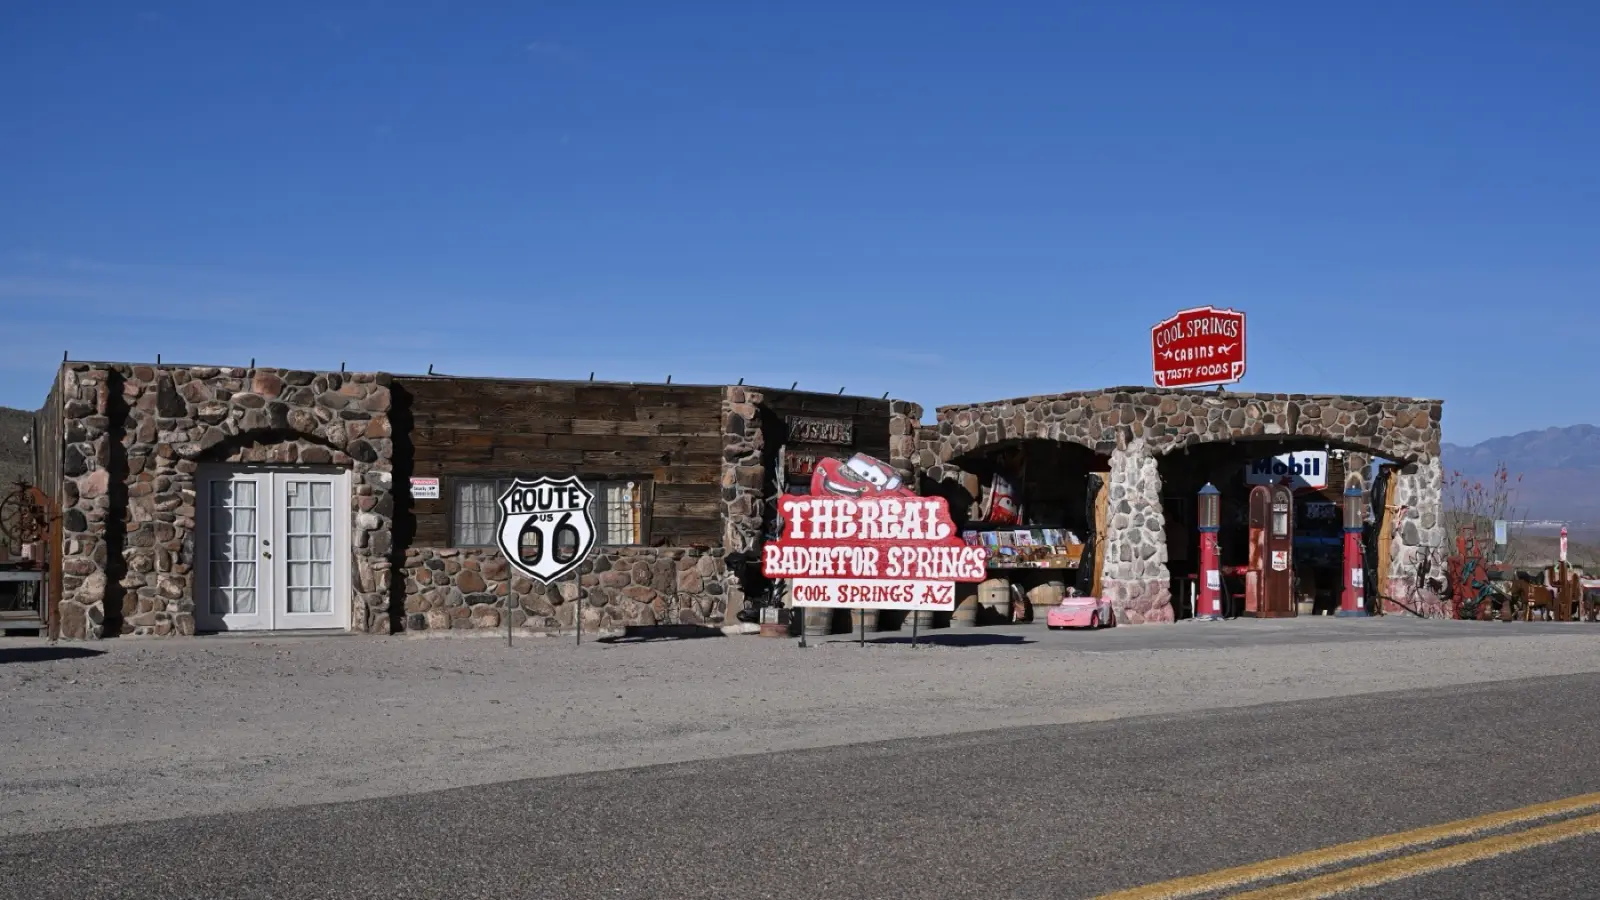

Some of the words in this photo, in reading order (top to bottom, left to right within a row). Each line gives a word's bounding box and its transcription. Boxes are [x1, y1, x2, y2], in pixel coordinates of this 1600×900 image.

[1156, 322, 1185, 348] COOL
[1186, 317, 1239, 338] SPRINGS
[1174, 345, 1215, 361] CABINS
[1166, 367, 1194, 380] TASTY
[1195, 362, 1229, 377] FOODS
[1252, 455, 1320, 476] Mobil
[511, 486, 580, 513] ROUTE
[539, 513, 554, 522] US
[783, 499, 858, 539] THE
[858, 499, 951, 541] REAL
[517, 512, 580, 567] 66
[764, 545, 879, 577] RADIATOR
[885, 546, 986, 579] SPRINGS
[793, 585, 831, 602] COOL
[837, 583, 915, 603] SPRINGS
[919, 585, 953, 605] AZ
